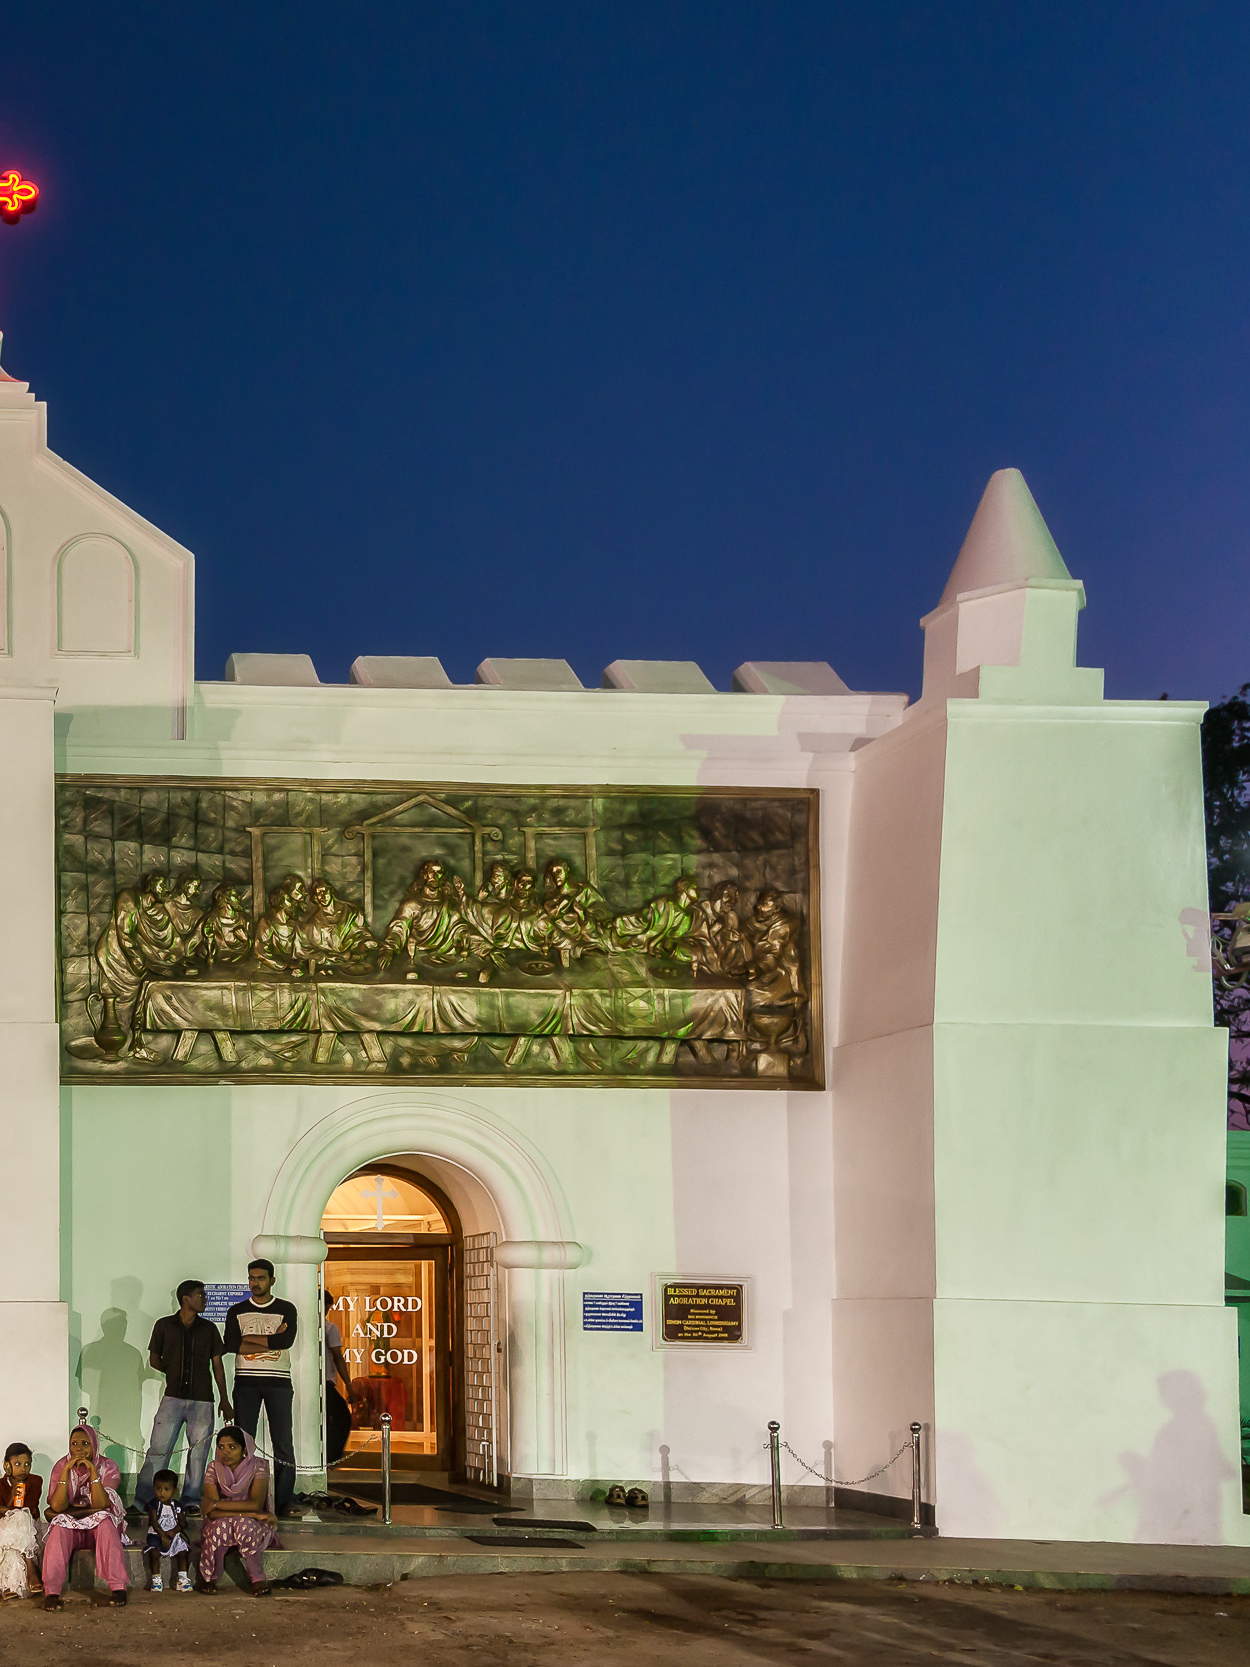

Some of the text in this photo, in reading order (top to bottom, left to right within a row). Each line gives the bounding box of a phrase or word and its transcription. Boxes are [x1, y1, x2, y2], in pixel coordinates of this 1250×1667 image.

[699, 1288, 737, 1296] SACRAMENT
[364, 1296, 422, 1312] LORD
[669, 1297, 736, 1306] ADORATION CHAPEL
[351, 1322, 398, 1338] AND
[371, 1348, 418, 1365] GOD
